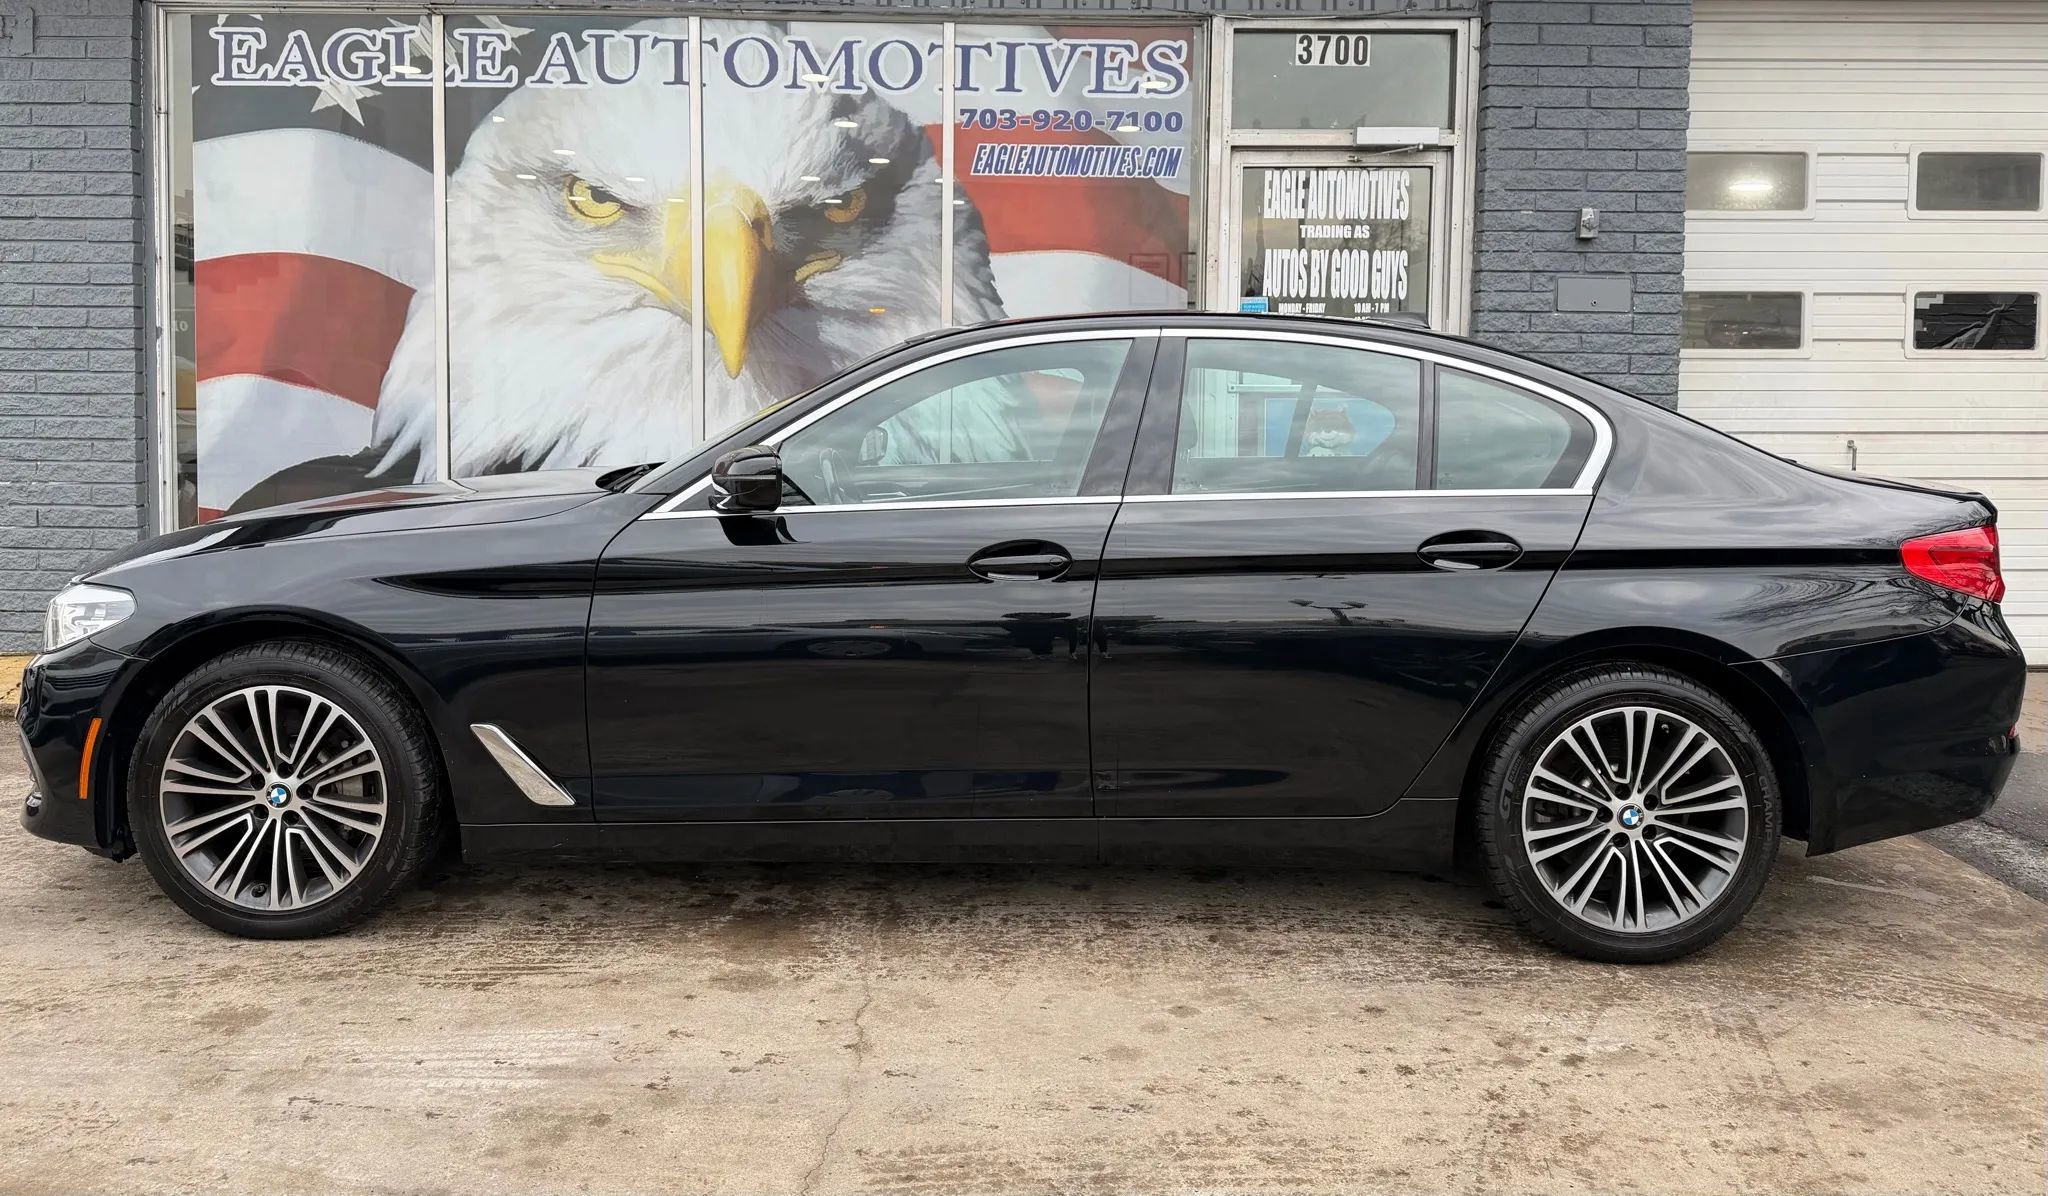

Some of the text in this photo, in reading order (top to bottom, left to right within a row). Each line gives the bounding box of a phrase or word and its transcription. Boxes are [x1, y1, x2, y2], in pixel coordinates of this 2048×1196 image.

[209, 26, 1188, 98] EAGLE AUTOMOTIVES
[1297, 34, 1369, 66] 3700
[959, 108, 1184, 133] 703-920-7100
[970, 143, 1184, 178] EAGLEAUTOMOTIVES.COM
[1263, 169, 1410, 220] EAGLE AUTOMOTIVES
[1300, 225, 1370, 239] TRADING AS
[1262, 248, 1409, 300] AUTOS BY GOOD GUYS
[1278, 302, 1302, 314] MONDAY
[1305, 303, 1326, 314] FRIDAY
[1354, 303, 1361, 314] 10
[1361, 303, 1372, 314] AM
[1375, 303, 1380, 314] 7
[1380, 303, 1390, 314] PM
